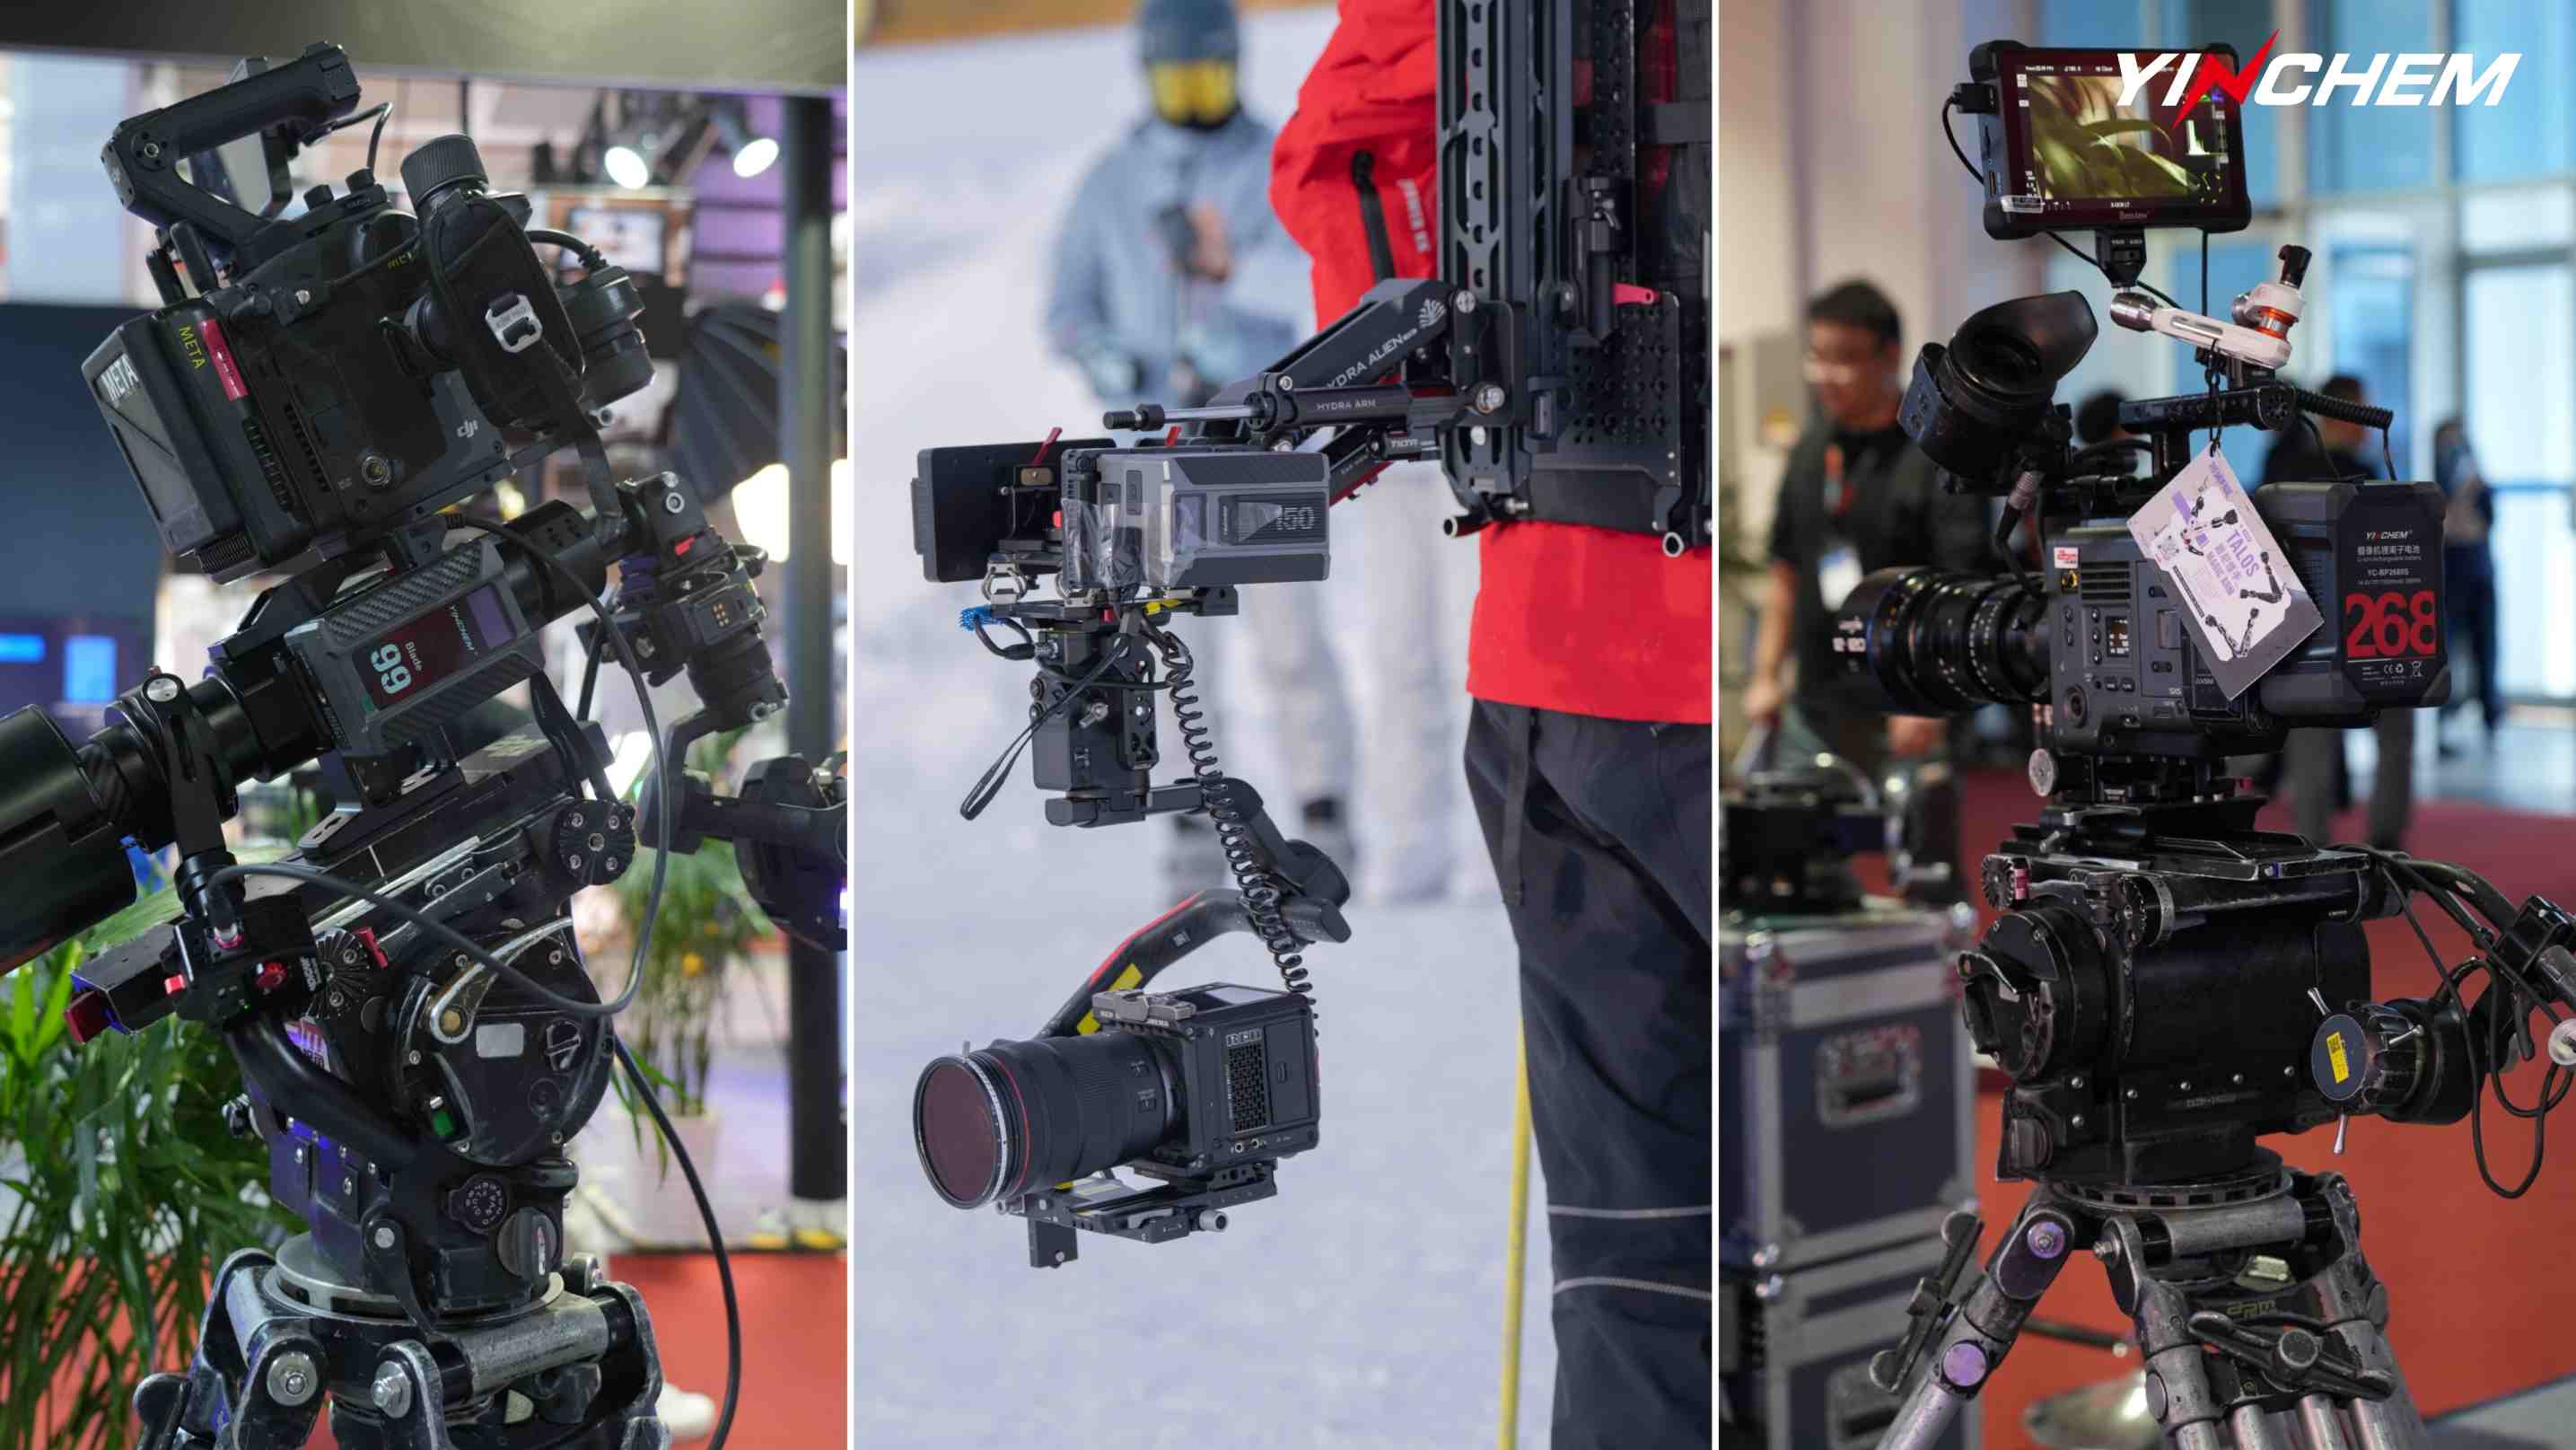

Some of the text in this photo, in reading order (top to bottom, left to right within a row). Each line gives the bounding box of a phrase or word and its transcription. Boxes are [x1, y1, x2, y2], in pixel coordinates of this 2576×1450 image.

[180, 326, 206, 369] META
[1327, 361, 1367, 388] YDRA
[1368, 332, 1406, 365] ALIEN
[101, 353, 140, 402] META
[1317, 400, 1377, 410] HYDRA ARM
[2226, 529, 2260, 577] TALOS
[2345, 590, 2435, 657] 268
[371, 643, 412, 694] 99
[404, 641, 424, 672] Blade
